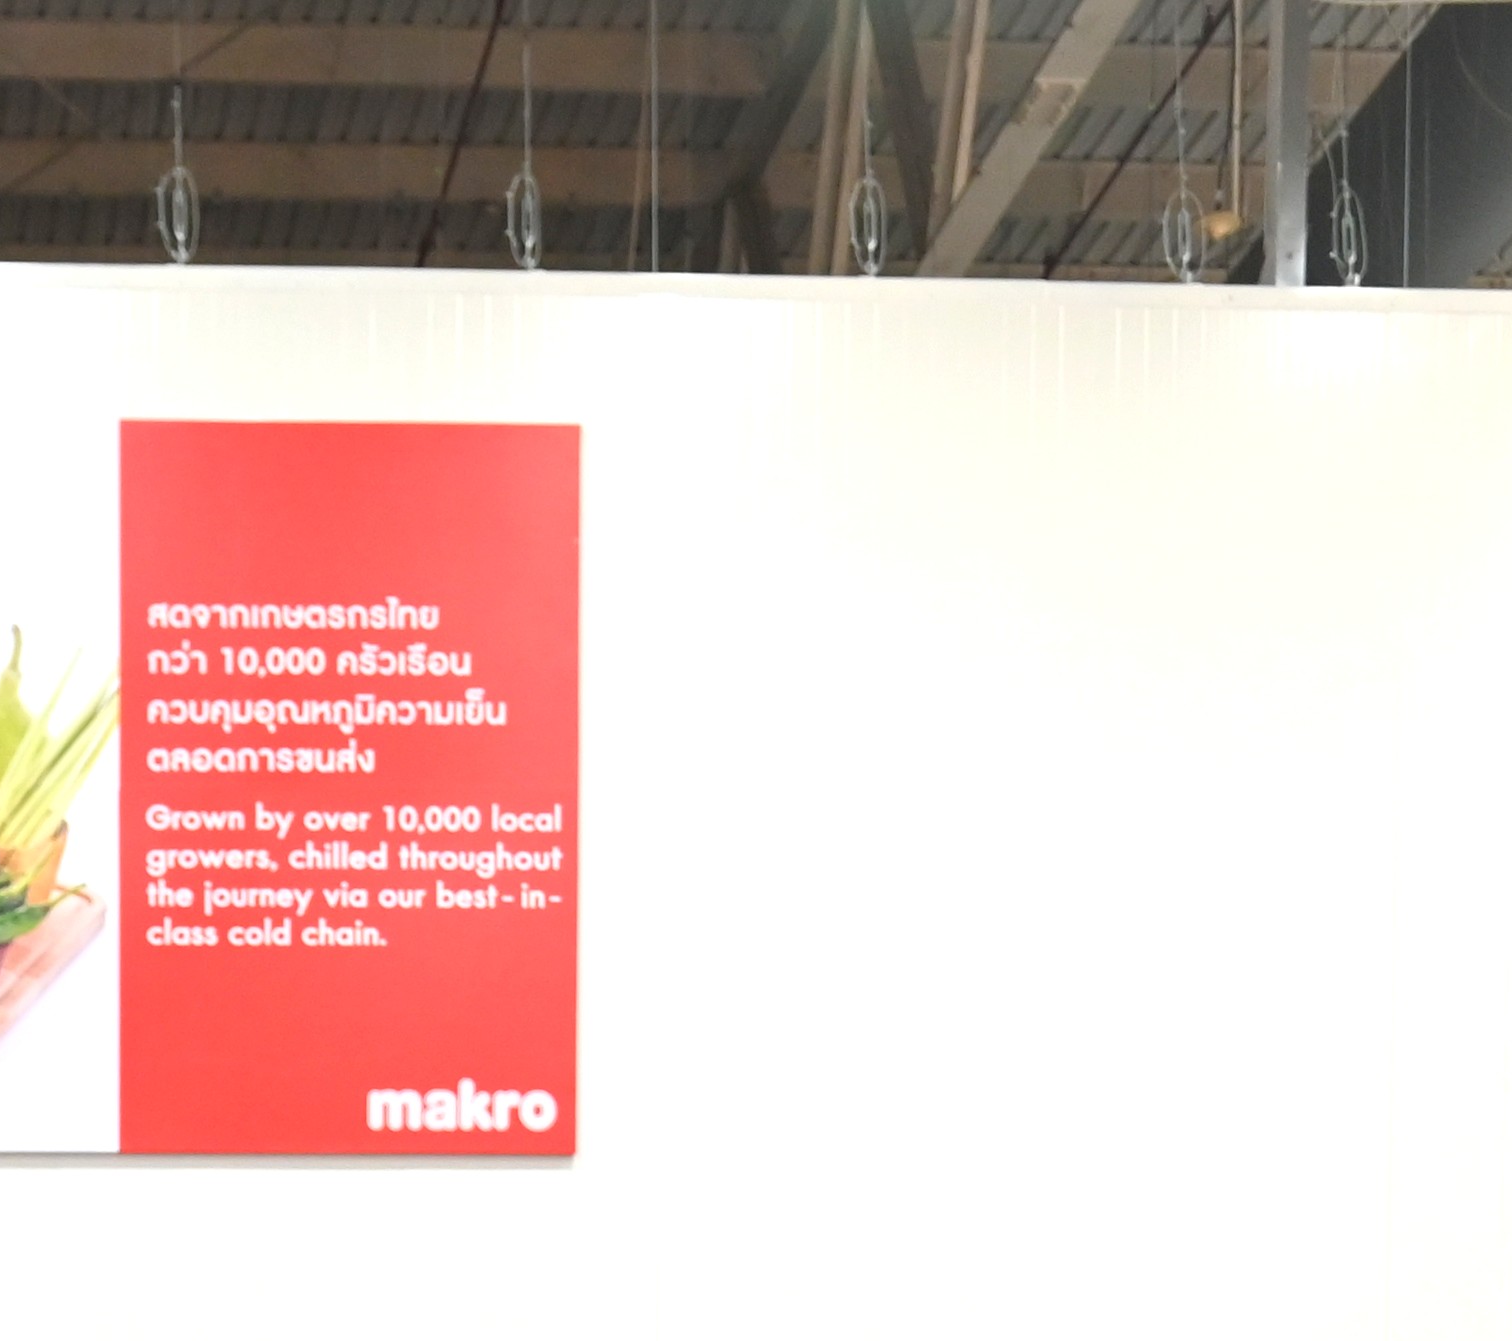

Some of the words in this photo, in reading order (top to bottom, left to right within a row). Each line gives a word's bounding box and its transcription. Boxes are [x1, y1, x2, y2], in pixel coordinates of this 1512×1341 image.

[147, 597, 440, 631] สดจากเกษตรกรไทย
[147, 641, 207, 676] กว่า
[221, 646, 326, 679] 10,000
[338, 642, 473, 677] ครัวเรือน
[147, 689, 507, 734] ควบคุมอุณหภูมิความเย็น
[147, 739, 376, 775] ตลอดการขนส่ง
[146, 804, 245, 832] Grown
[256, 802, 294, 839] by
[304, 811, 371, 832] over
[383, 805, 481, 837] 10,000
[491, 803, 563, 832] local
[146, 848, 279, 877] growers,
[288, 842, 388, 871] chilled
[399, 843, 563, 878] throughout
[147, 881, 193, 907] the
[203, 881, 313, 917] journey
[323, 881, 369, 907] via
[379, 887, 426, 908] our
[146, 919, 218, 946] class
[228, 919, 292, 946] cold
[301, 919, 387, 947] chain.
[366, 1078, 558, 1131] makro
